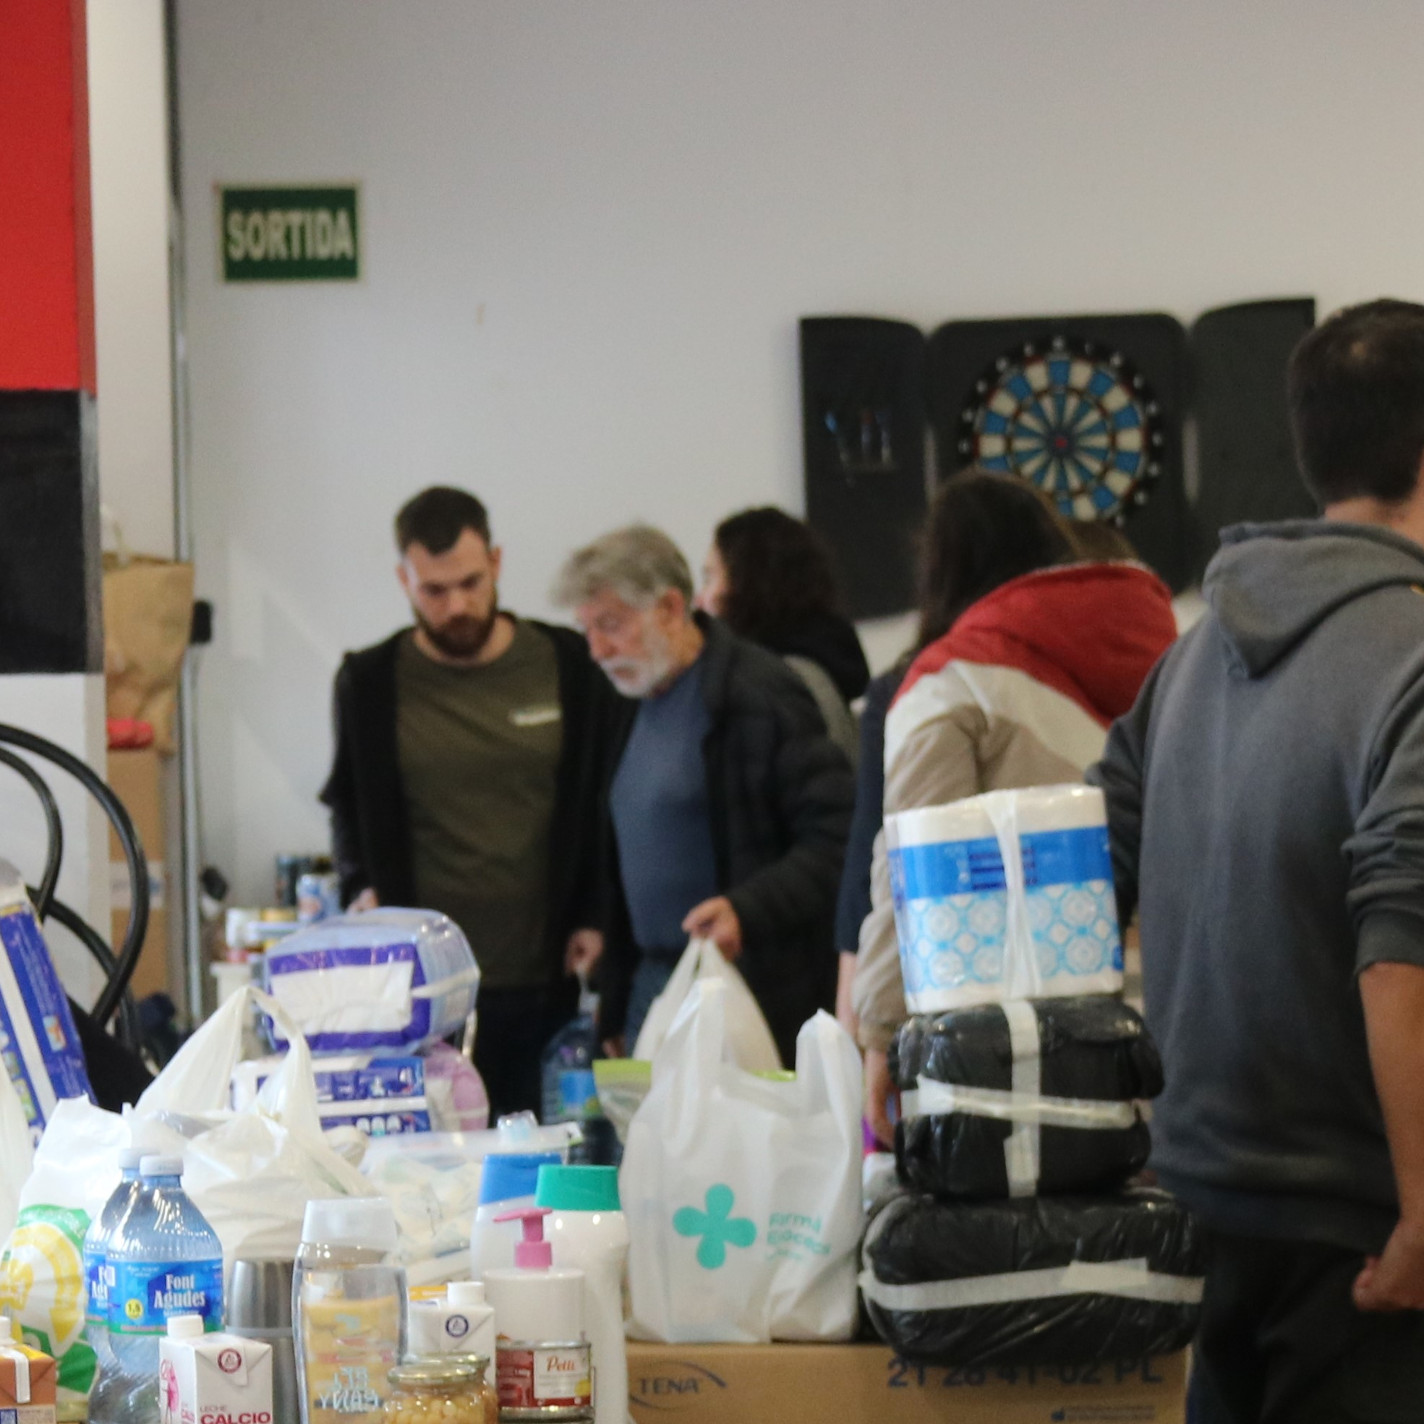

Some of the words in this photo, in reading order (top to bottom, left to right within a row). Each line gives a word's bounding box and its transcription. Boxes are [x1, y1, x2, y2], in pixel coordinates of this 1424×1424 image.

[227, 208, 354, 261] SORTIDA
[165, 1273, 195, 1290] Font
[154, 1290, 206, 1309] Agudes
[638, 1376, 700, 1395] TENA
